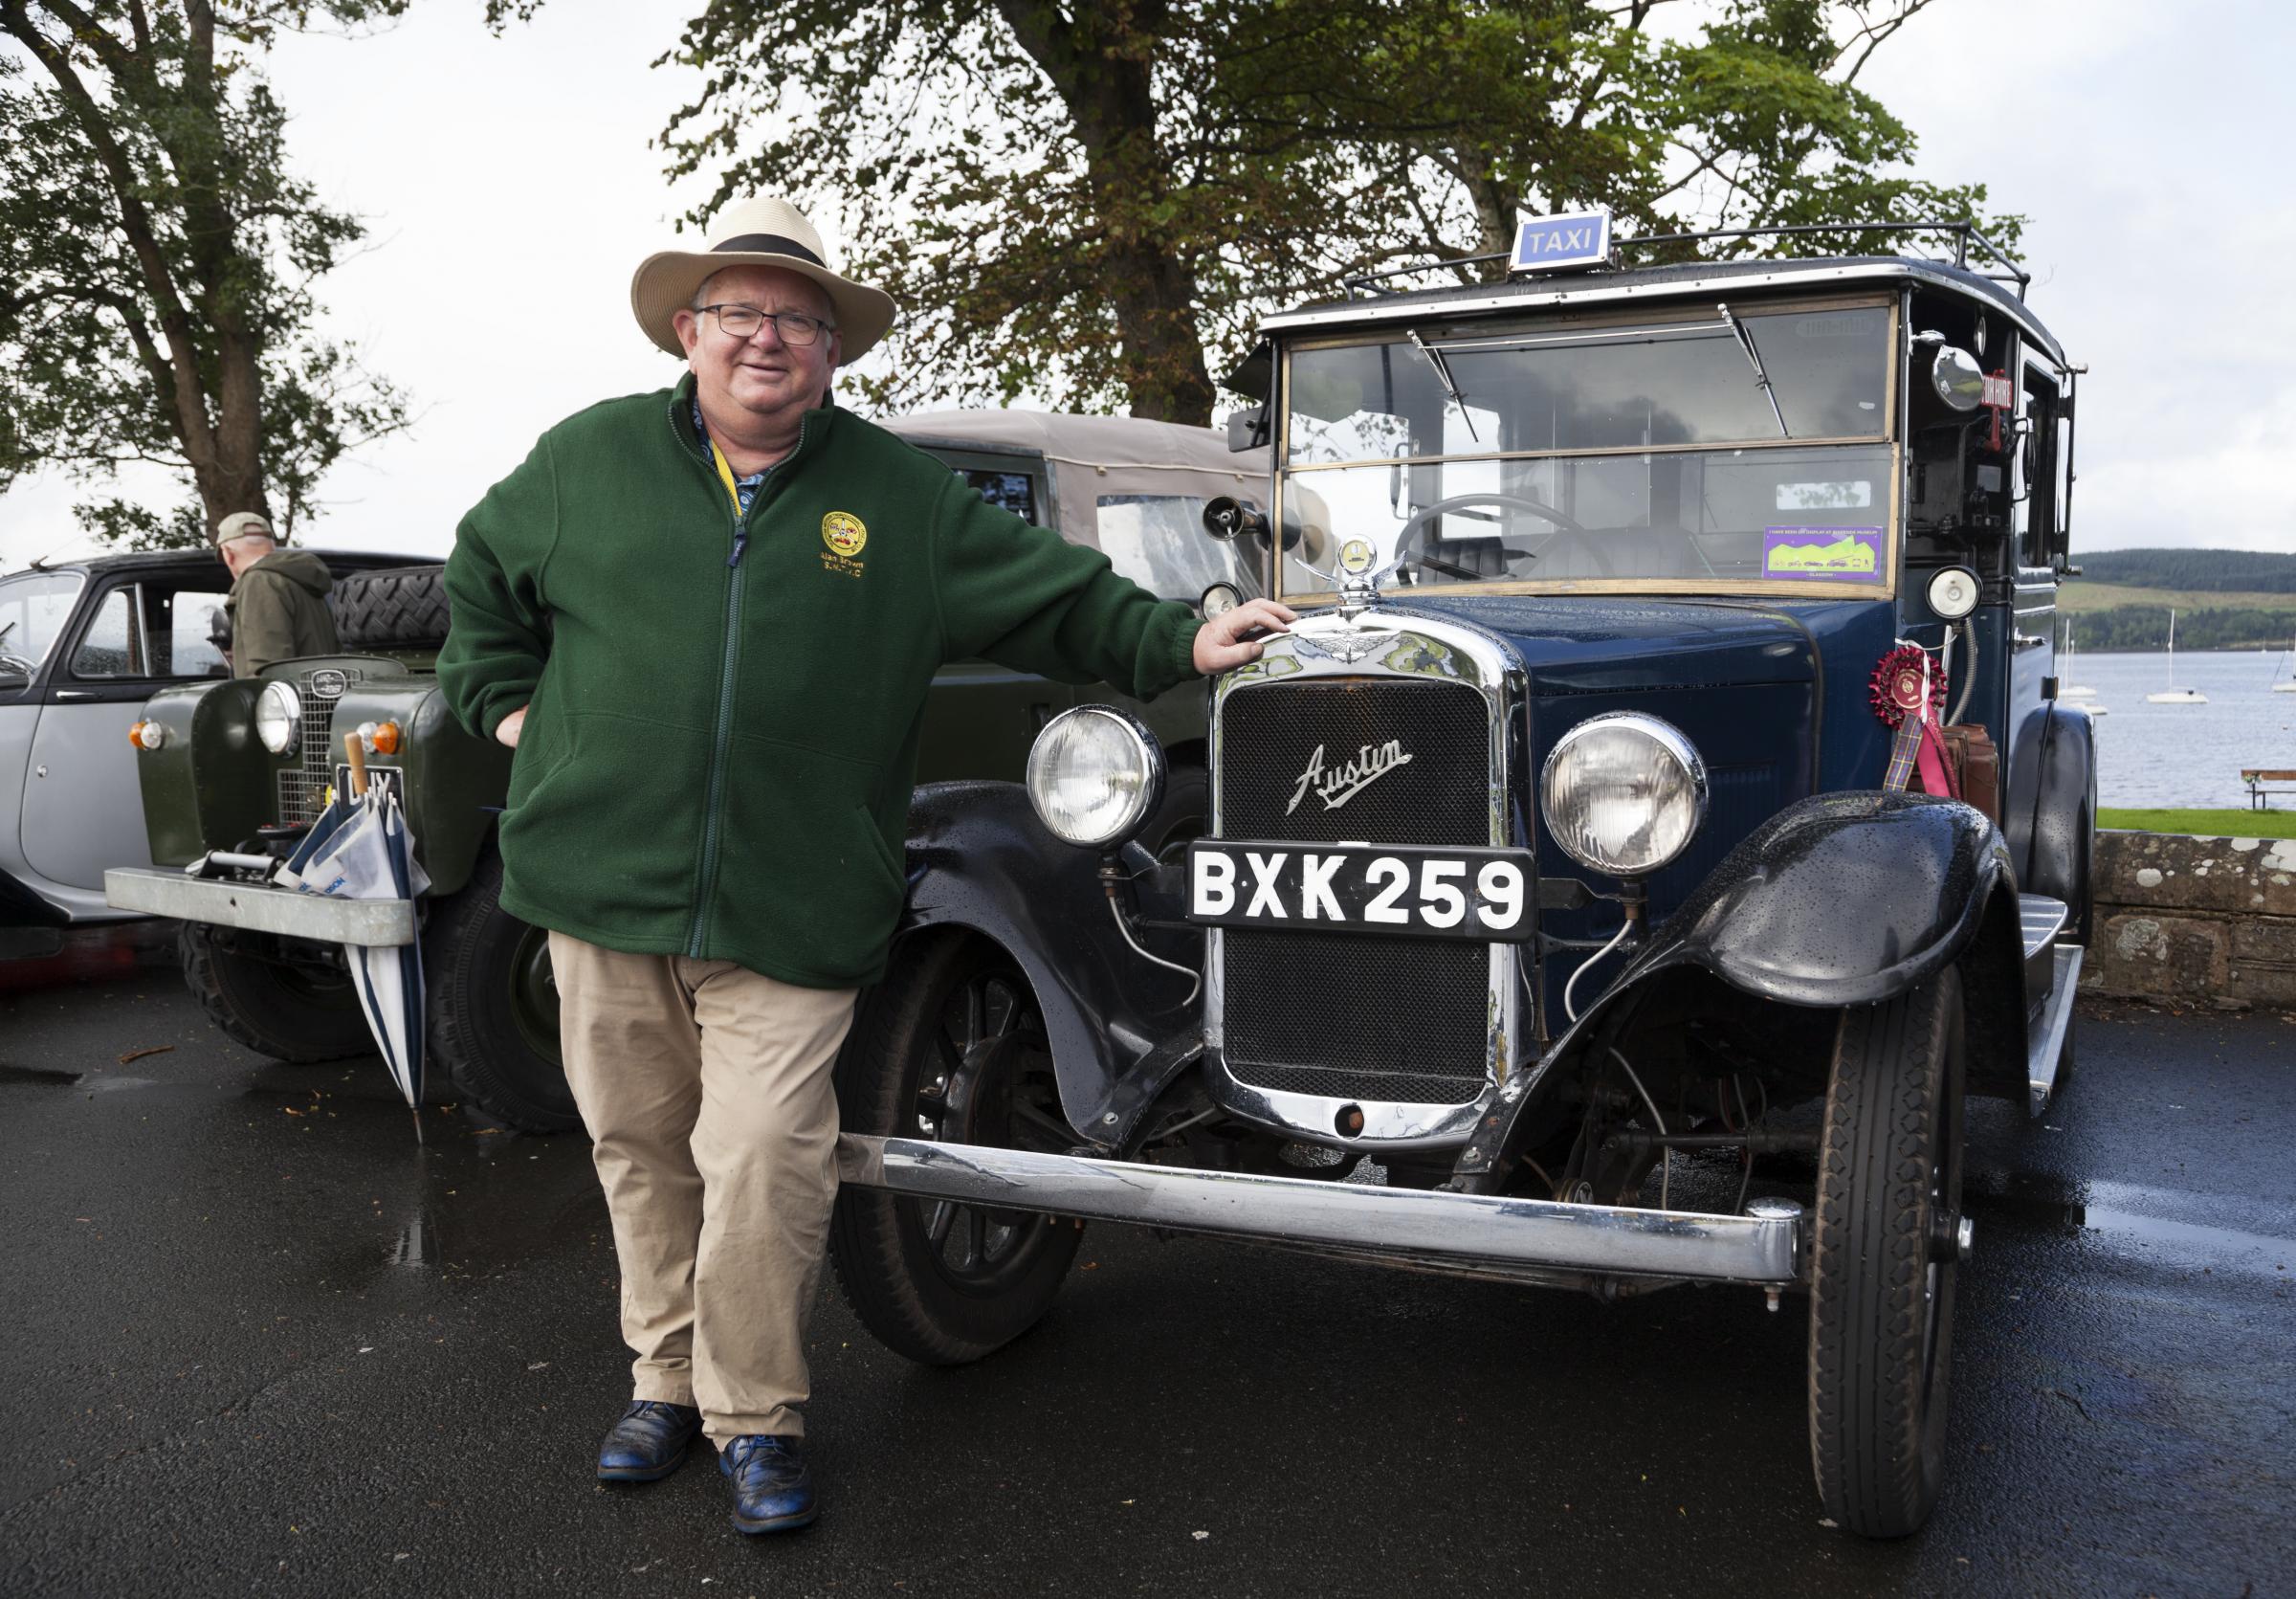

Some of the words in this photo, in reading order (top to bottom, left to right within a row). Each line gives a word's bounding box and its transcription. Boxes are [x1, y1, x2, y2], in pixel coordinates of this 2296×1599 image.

[1530, 228, 1592, 255] TAXI
[1995, 377, 2012, 409] HIRE
[1286, 740, 1402, 815] Austin
[1194, 851, 1347, 921] BXK
[1364, 856, 1524, 929] 259
